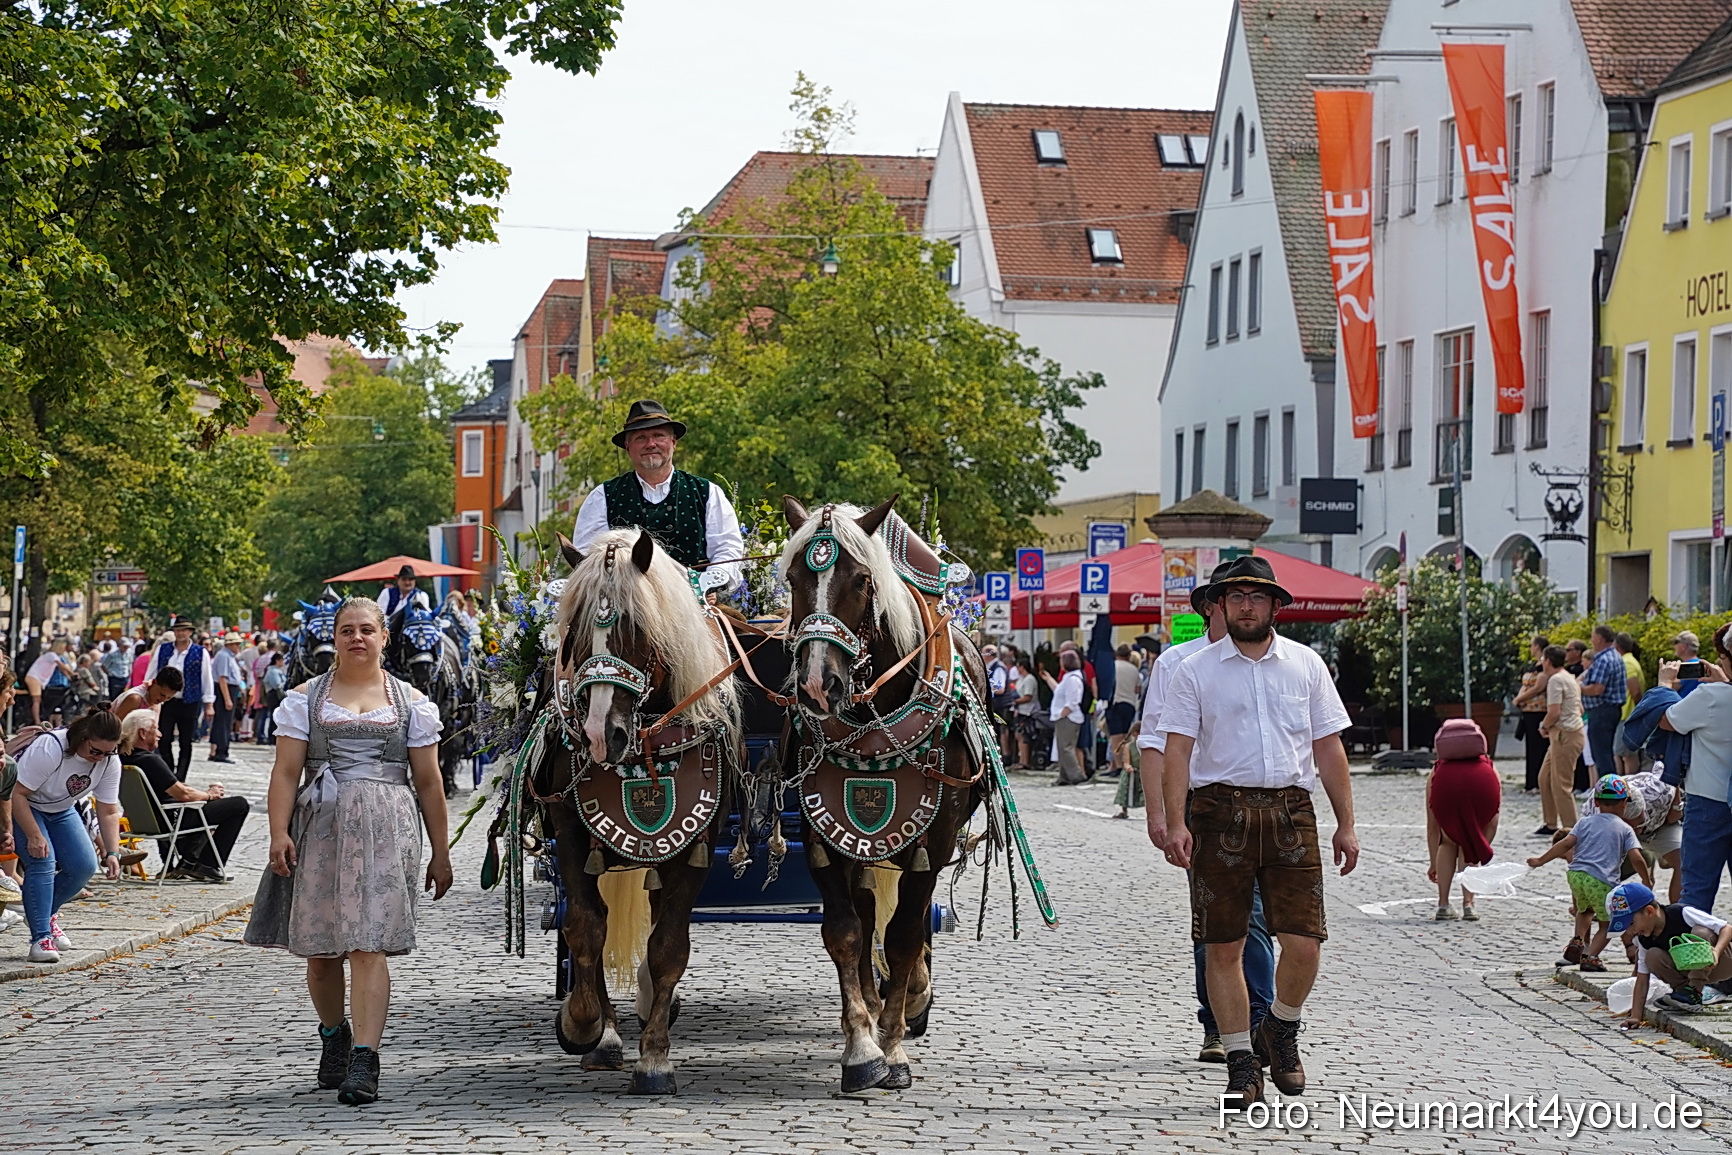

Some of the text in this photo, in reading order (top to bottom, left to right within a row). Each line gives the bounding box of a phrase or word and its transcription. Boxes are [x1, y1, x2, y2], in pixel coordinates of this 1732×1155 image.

[1465, 144, 1515, 290] SALE
[1686, 271, 1731, 318] HOTEL
[1304, 501, 1355, 512] SCHMID
[991, 576, 1006, 598] P
[1021, 578, 1042, 588] TAXI
[1086, 566, 1104, 591] P
[582, 789, 716, 857] DIETERSDORF
[805, 793, 936, 857] DIETERSDORF
